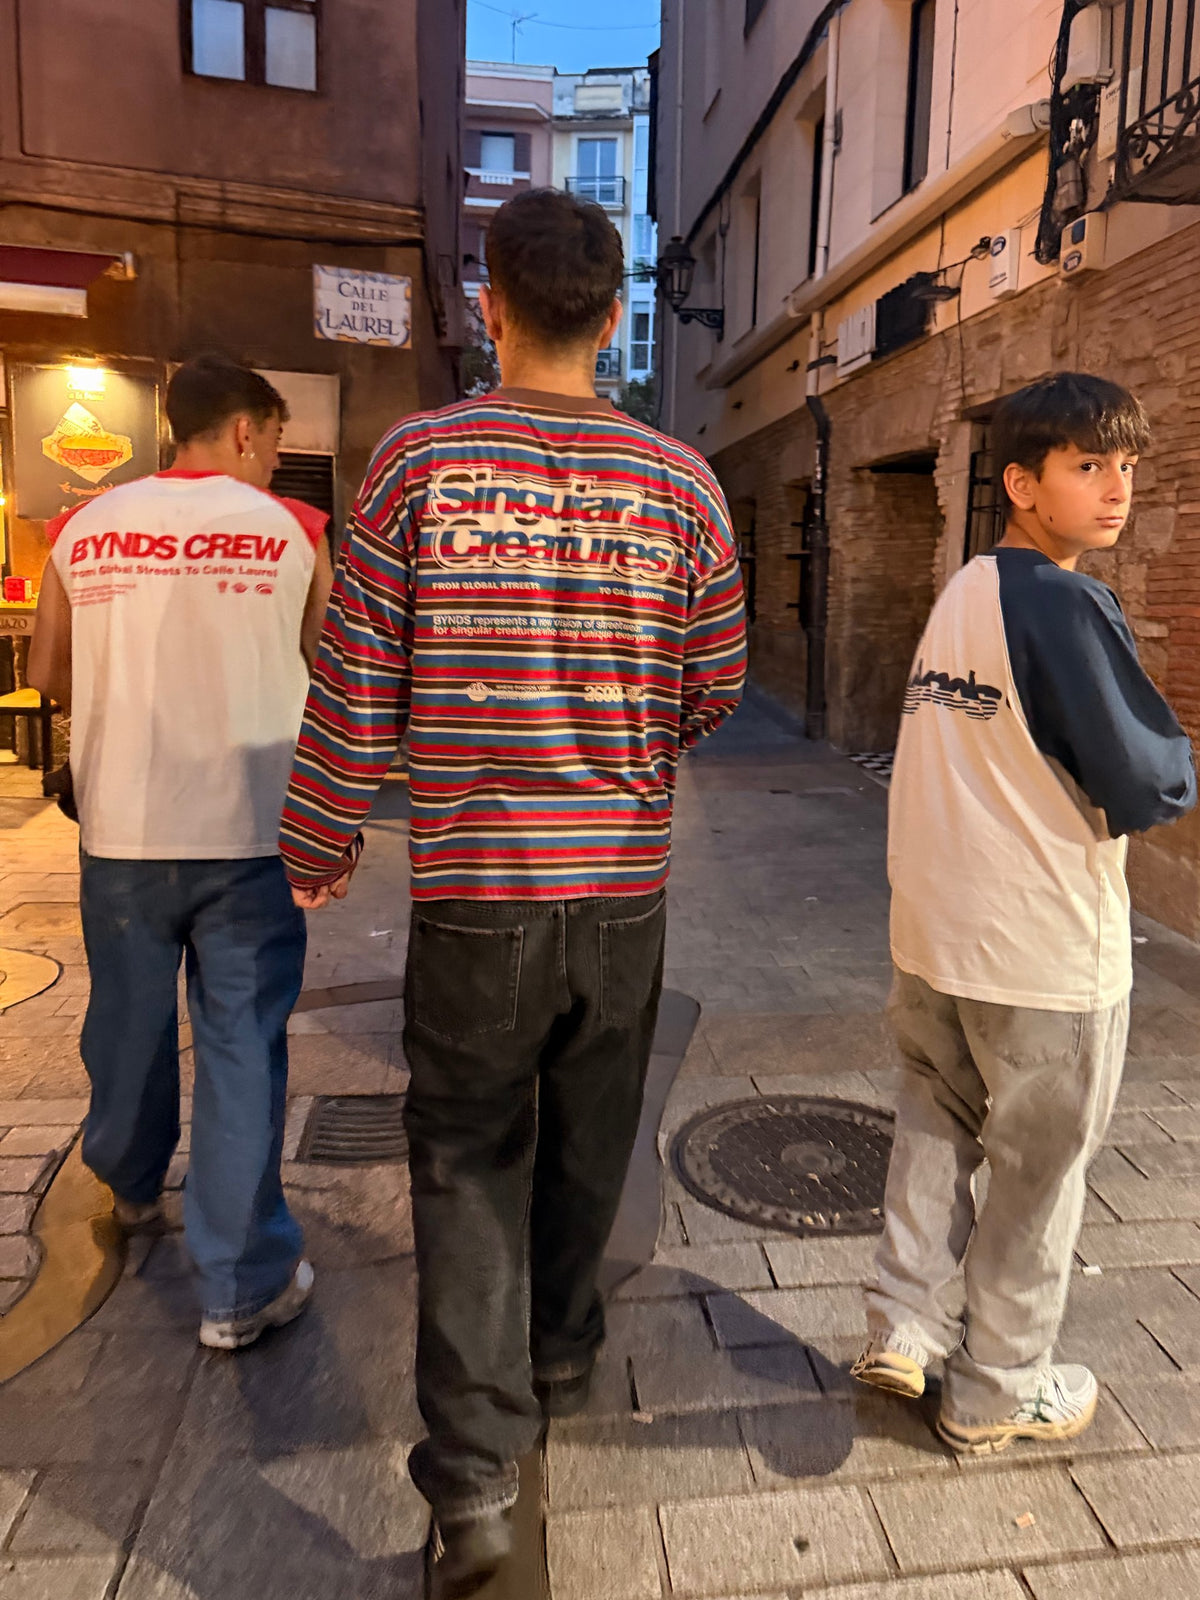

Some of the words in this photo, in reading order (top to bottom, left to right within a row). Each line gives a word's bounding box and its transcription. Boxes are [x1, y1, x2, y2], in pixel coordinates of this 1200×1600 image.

[338, 281, 388, 301] CALLE
[352, 301, 377, 313] DEL
[326, 308, 400, 336] LAUREL
[70, 532, 178, 566] BYNDS
[183, 533, 288, 563] CREW
[431, 517, 678, 583] Creatures
[136, 565, 181, 576] Streets
[185, 566, 199, 576] To
[432, 582, 460, 591] FROM
[461, 581, 499, 591] GLOBAL
[500, 581, 541, 591] STREETS
[598, 586, 611, 596] TO
[433, 615, 472, 626] BYNDS
[473, 616, 528, 626] represents
[529, 618, 537, 626] a
[553, 619, 582, 629] vision
[583, 620, 595, 630] of
[433, 626, 449, 636] for
[450, 626, 494, 637] singular
[495, 627, 543, 637] creatures
[559, 629, 580, 641] stay
[581, 630, 613, 641] unique
